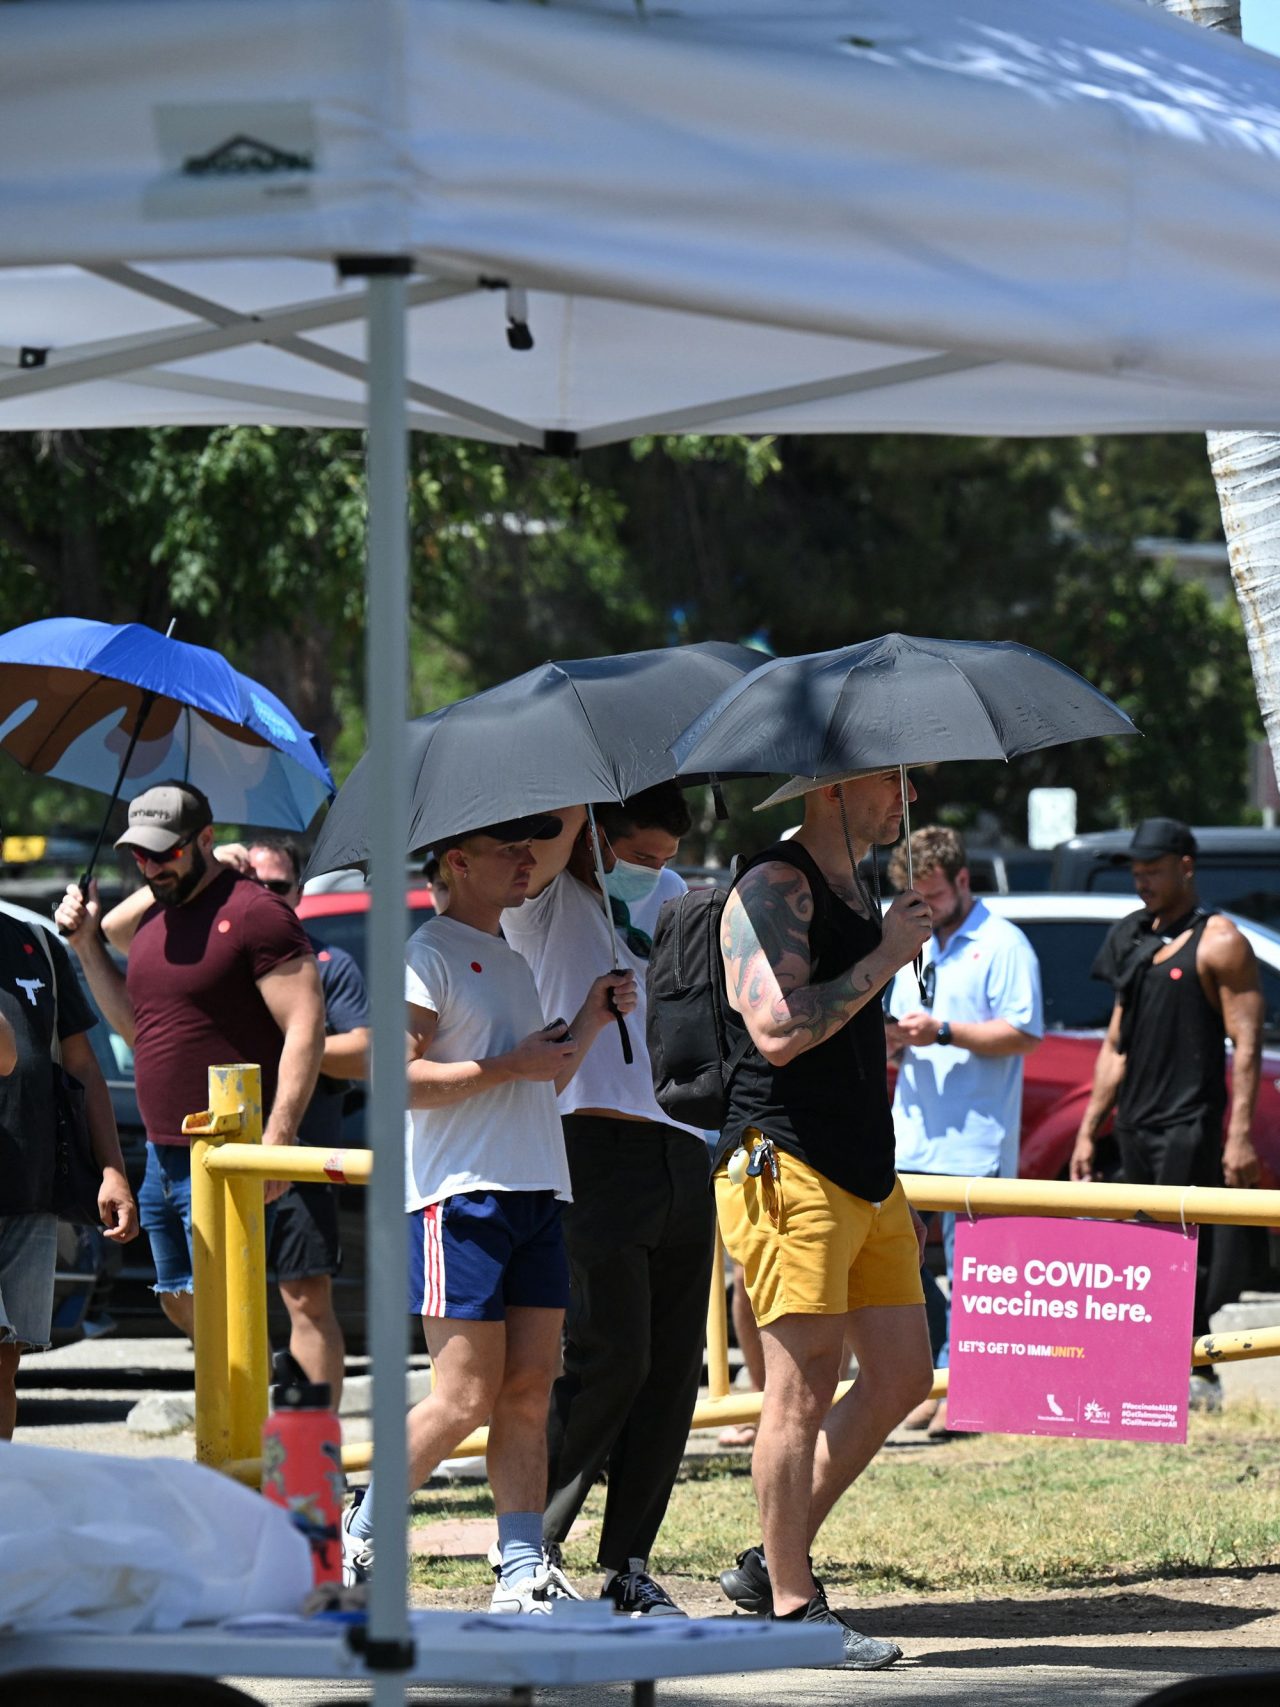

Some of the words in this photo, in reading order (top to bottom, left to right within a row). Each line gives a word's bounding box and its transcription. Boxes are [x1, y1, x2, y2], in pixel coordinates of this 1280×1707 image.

[961, 1256, 1018, 1284] Free
[1024, 1259, 1152, 1291] COVID-19
[961, 1290, 1079, 1319] vaccines
[1085, 1294, 1153, 1323] here.
[958, 1340, 986, 1353] LET'S
[987, 1342, 1009, 1355] GET
[1010, 1343, 1026, 1356] TO
[1027, 1344, 1085, 1359] IMMUNITY.
